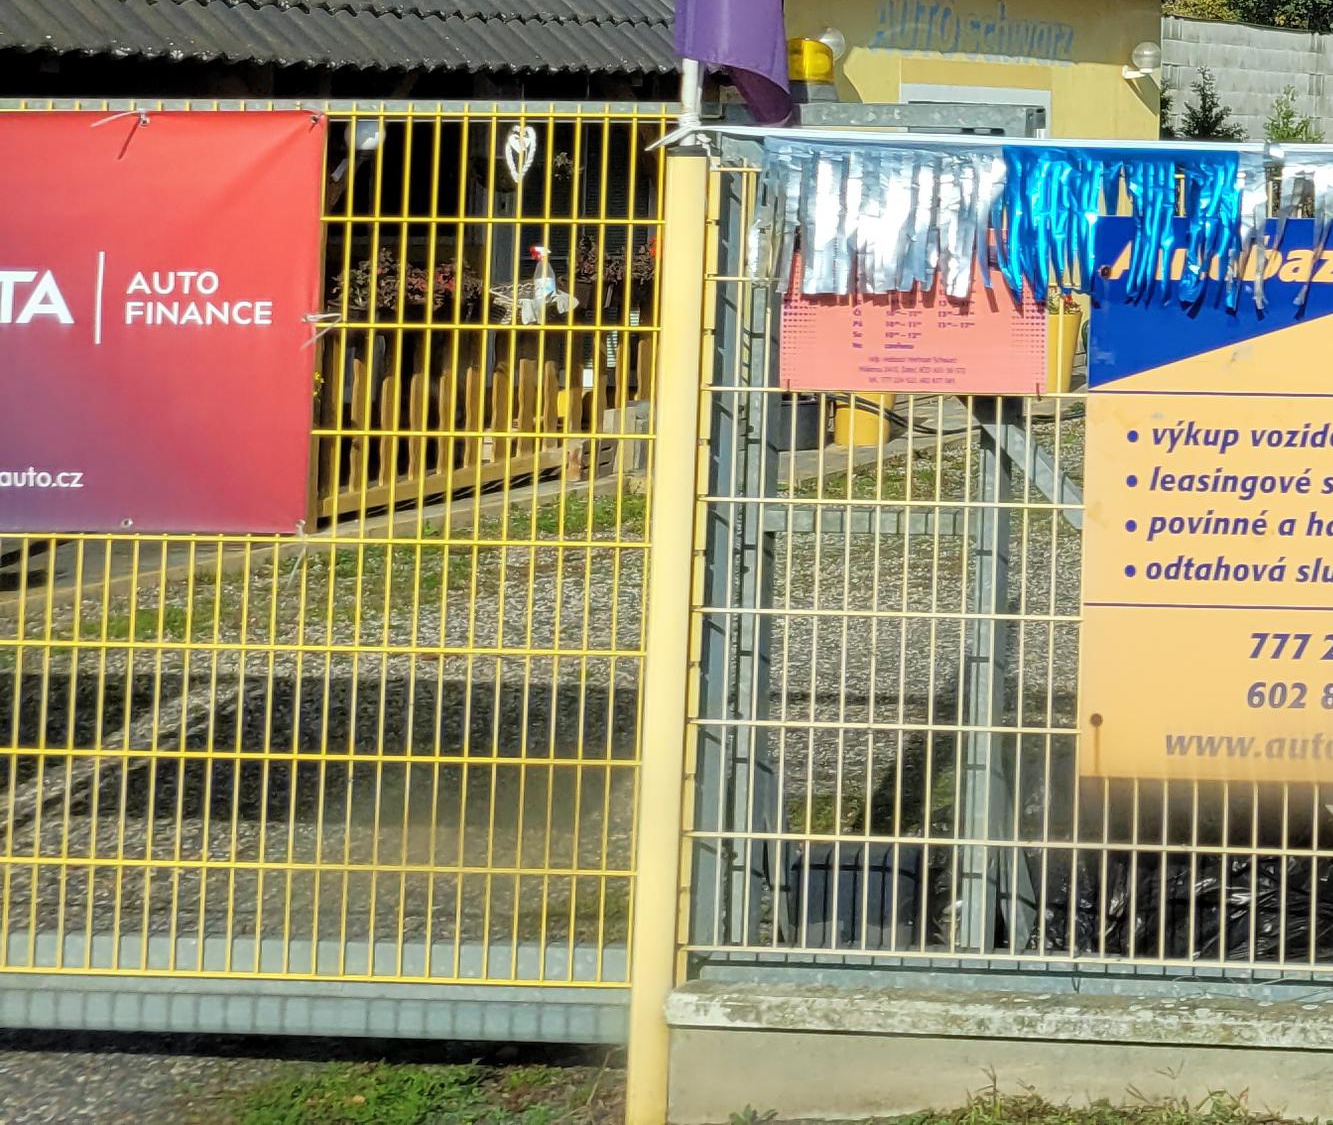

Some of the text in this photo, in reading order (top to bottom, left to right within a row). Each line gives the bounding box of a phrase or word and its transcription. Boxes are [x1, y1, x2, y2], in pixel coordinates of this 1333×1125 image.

[126, 271, 219, 295] AUTO
[125, 301, 273, 324] FINANCE
[1152, 421, 1239, 454] výkup
[1149, 466, 1313, 501] leasingové
[1146, 509, 1269, 542] povinné
[1277, 518, 1297, 537] a
[1145, 554, 1287, 582] odtahová
[1248, 632, 1313, 660] 777
[1246, 681, 1308, 710] 602
